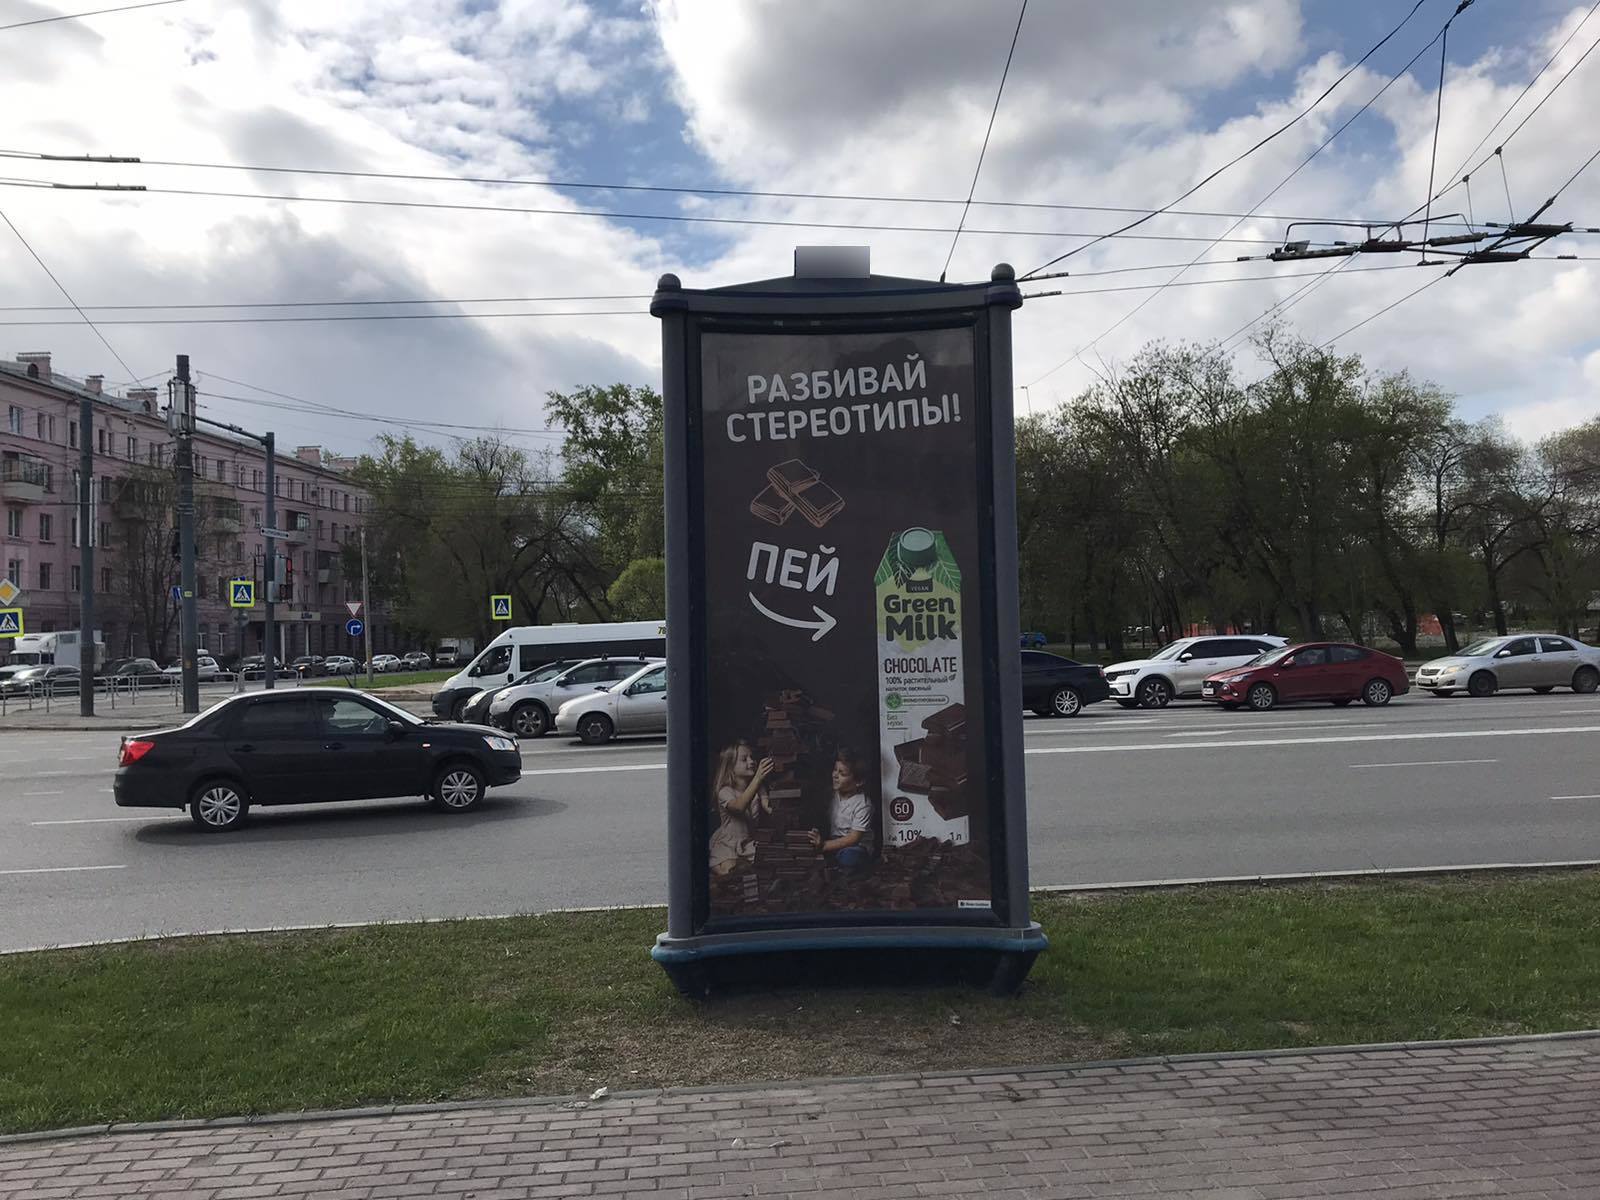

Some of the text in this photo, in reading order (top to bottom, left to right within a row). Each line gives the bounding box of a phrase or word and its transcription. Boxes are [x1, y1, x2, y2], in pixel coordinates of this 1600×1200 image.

[747, 353, 927, 404] РАЗБИВАЙ
[726, 393, 961, 442] СТЕРЕОТИПЫ!
[746, 541, 840, 596] ПЕЙ
[884, 594, 956, 615] Green
[886, 613, 958, 642] Milk
[884, 657, 957, 674] CHOCOLATE
[885, 676, 948, 686] 100% растительный
[894, 802, 910, 814] 60
